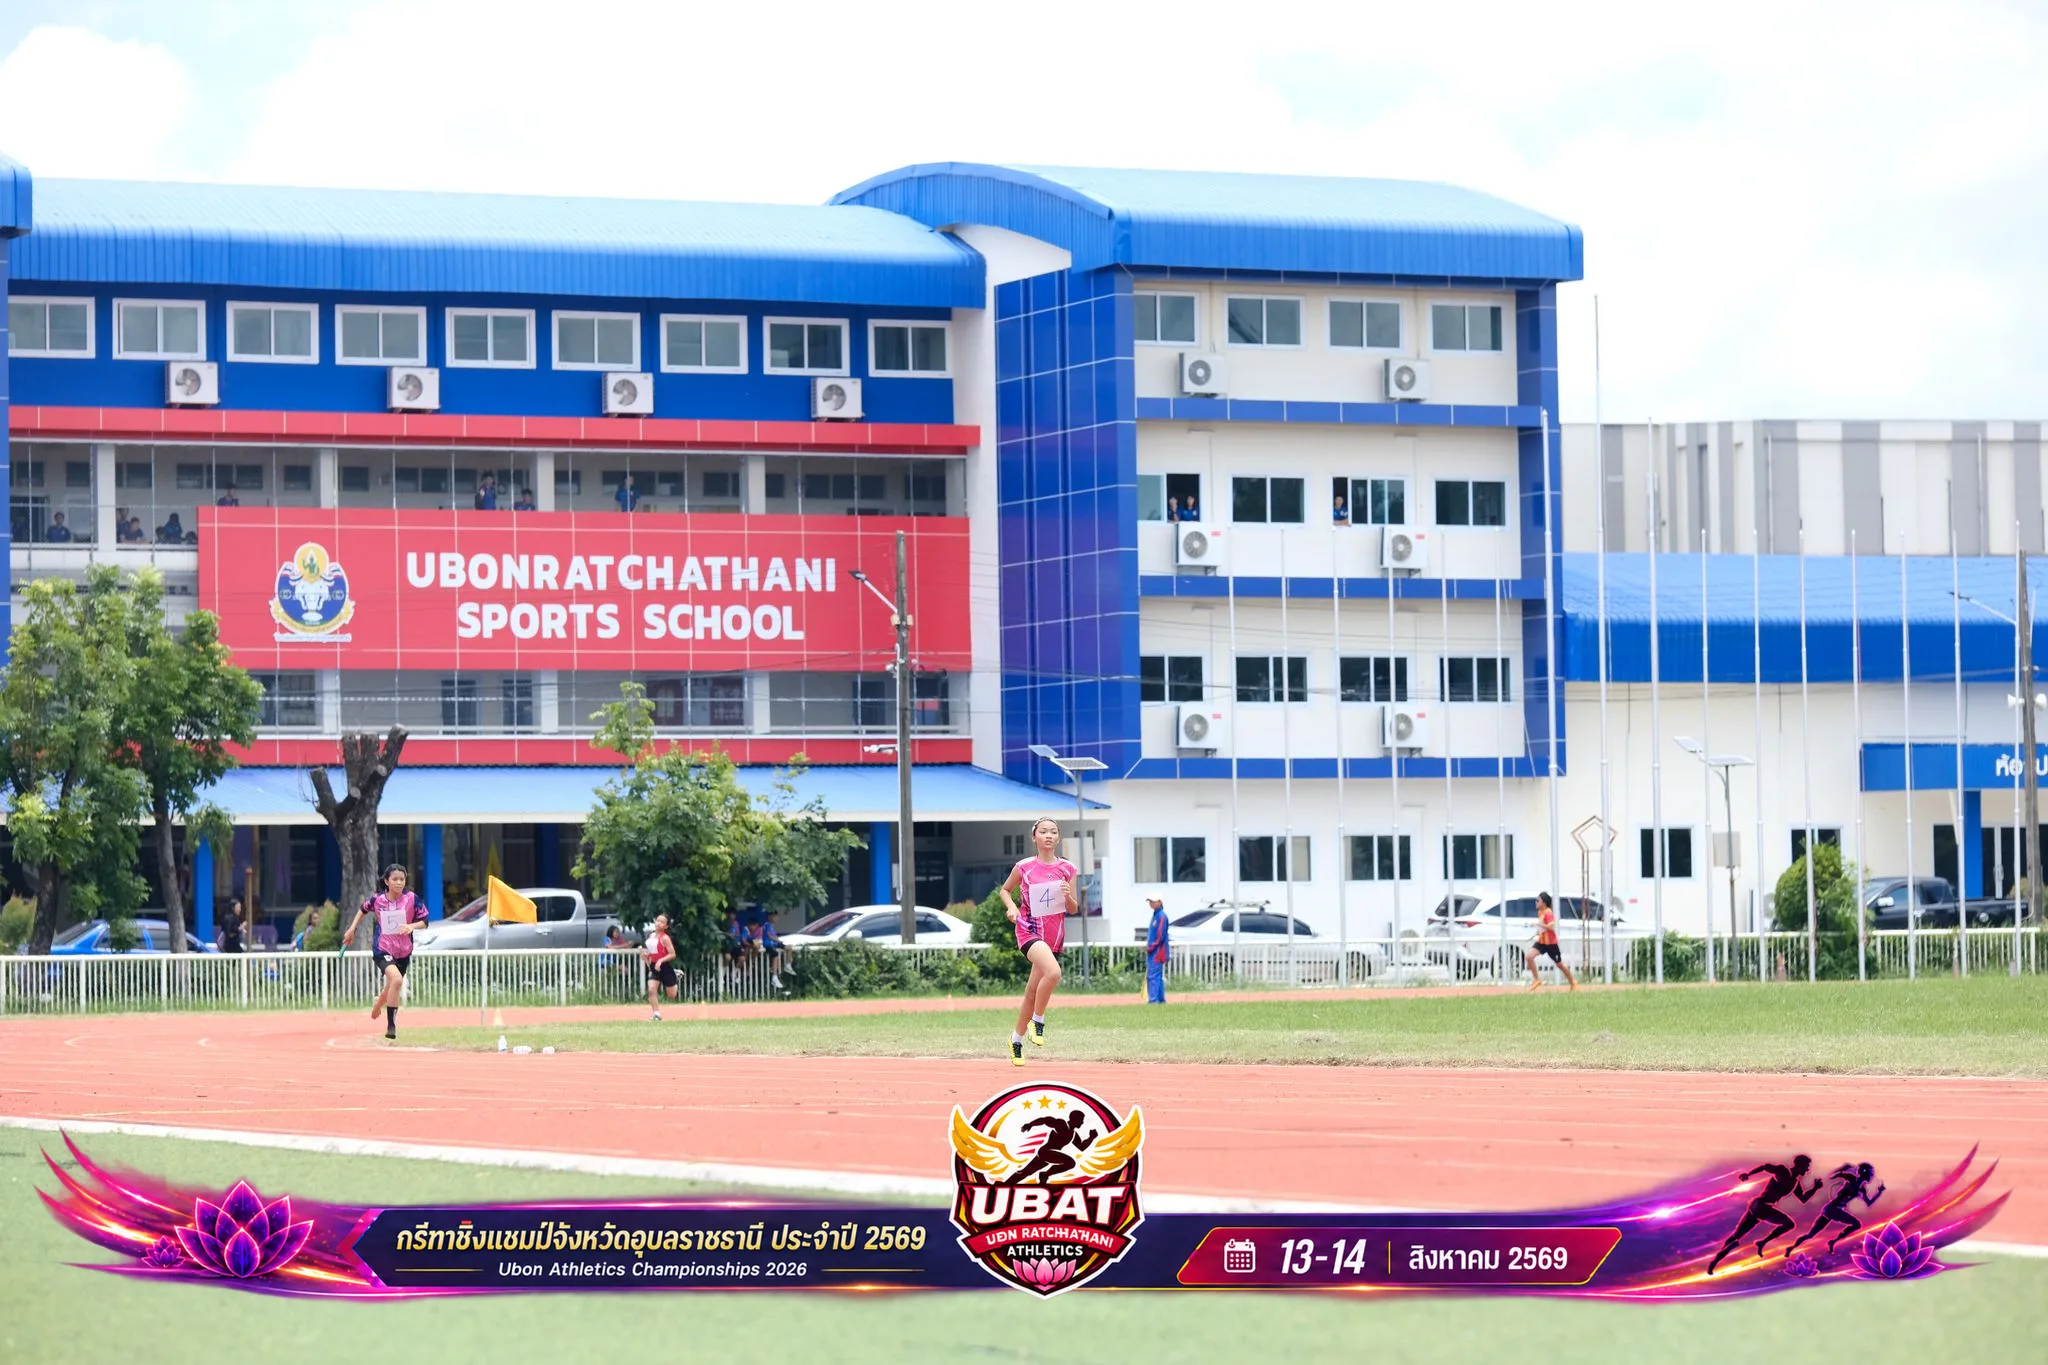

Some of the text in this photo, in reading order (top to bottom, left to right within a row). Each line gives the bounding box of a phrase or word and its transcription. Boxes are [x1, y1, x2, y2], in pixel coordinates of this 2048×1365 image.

[407, 552, 836, 592] UBONRATCHATHANI
[457, 602, 805, 640] SPORTS SCHOOL
[1039, 888, 1055, 908] 4
[387, 914, 399, 931] 5
